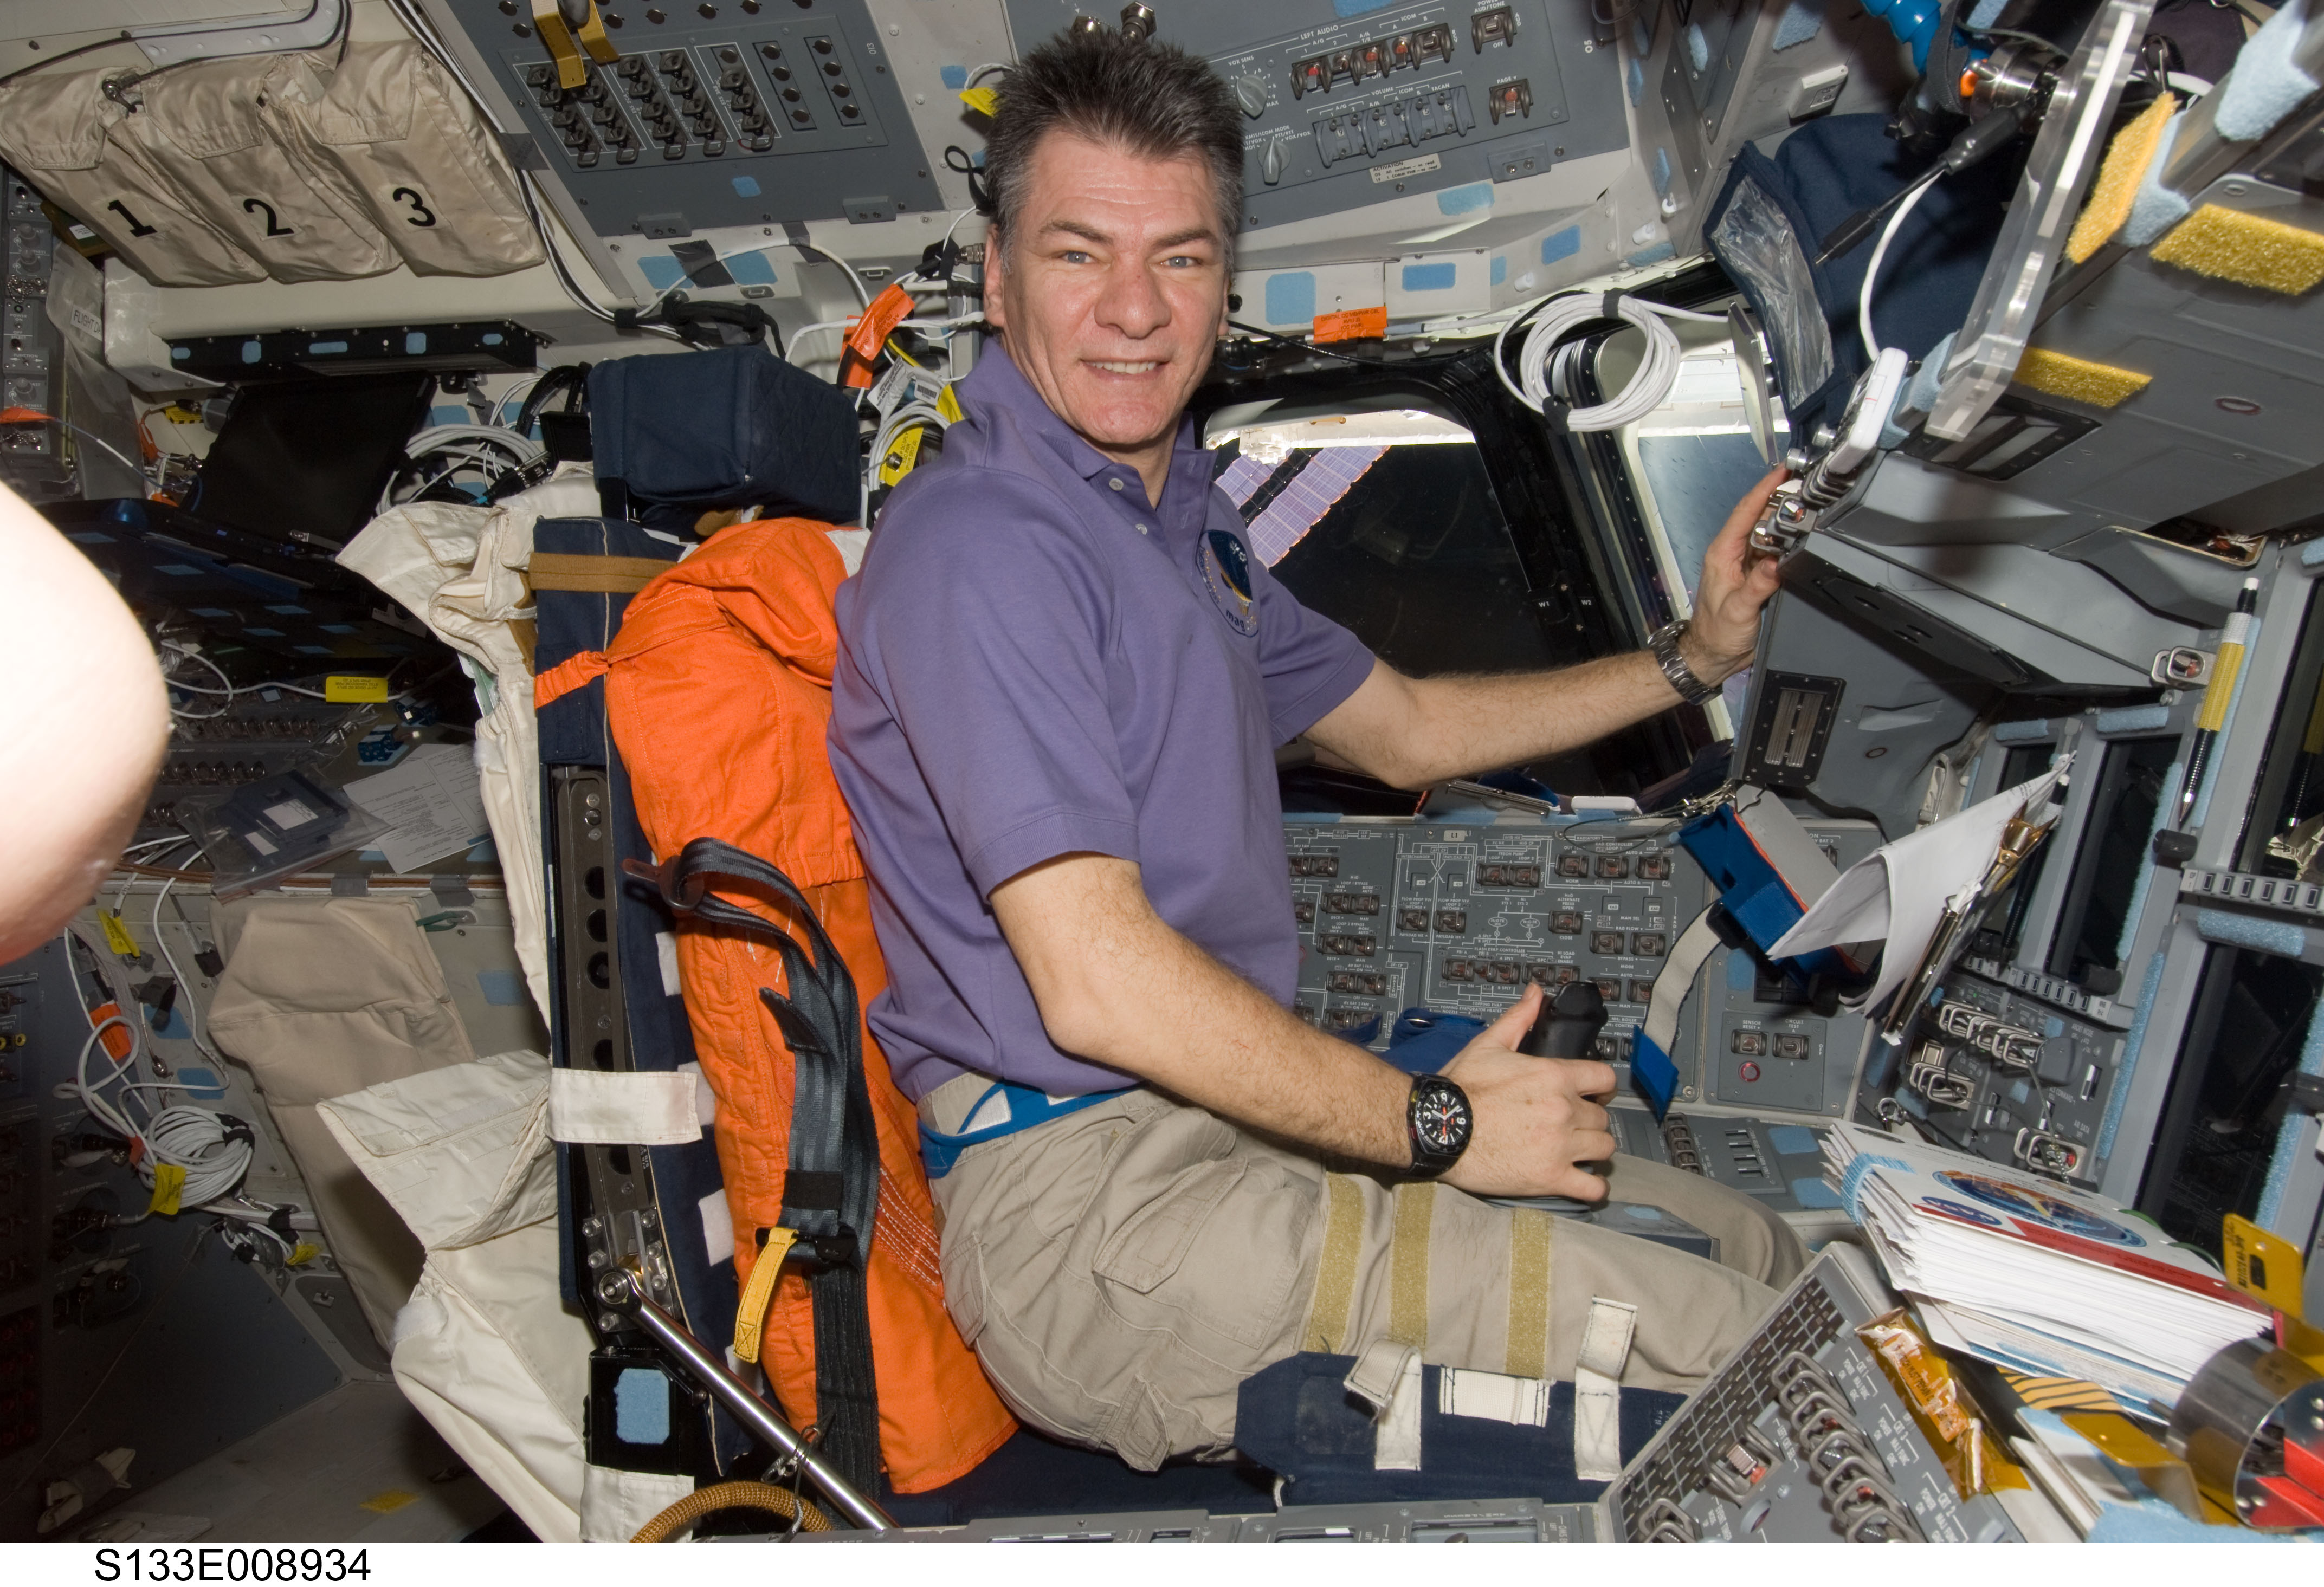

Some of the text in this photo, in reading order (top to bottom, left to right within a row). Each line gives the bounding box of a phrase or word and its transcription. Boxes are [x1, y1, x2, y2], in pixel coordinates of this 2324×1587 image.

[1474, 1, 1505, 13] AUD/TONE
[1301, 25, 1338, 40] LEFT AUDIO
[1229, 58, 1240, 66] VOX
[1371, 87, 1394, 96] VOLUME
[1431, 83, 1450, 92] TACAN
[1285, 131, 1311, 140] VOX/VOX
[1373, 161, 1403, 172] ACTIVATION
[393, 187, 436, 228] 3
[107, 200, 157, 237] 1
[243, 198, 295, 236] 2
[74, 310, 94, 333] FLIGHT
